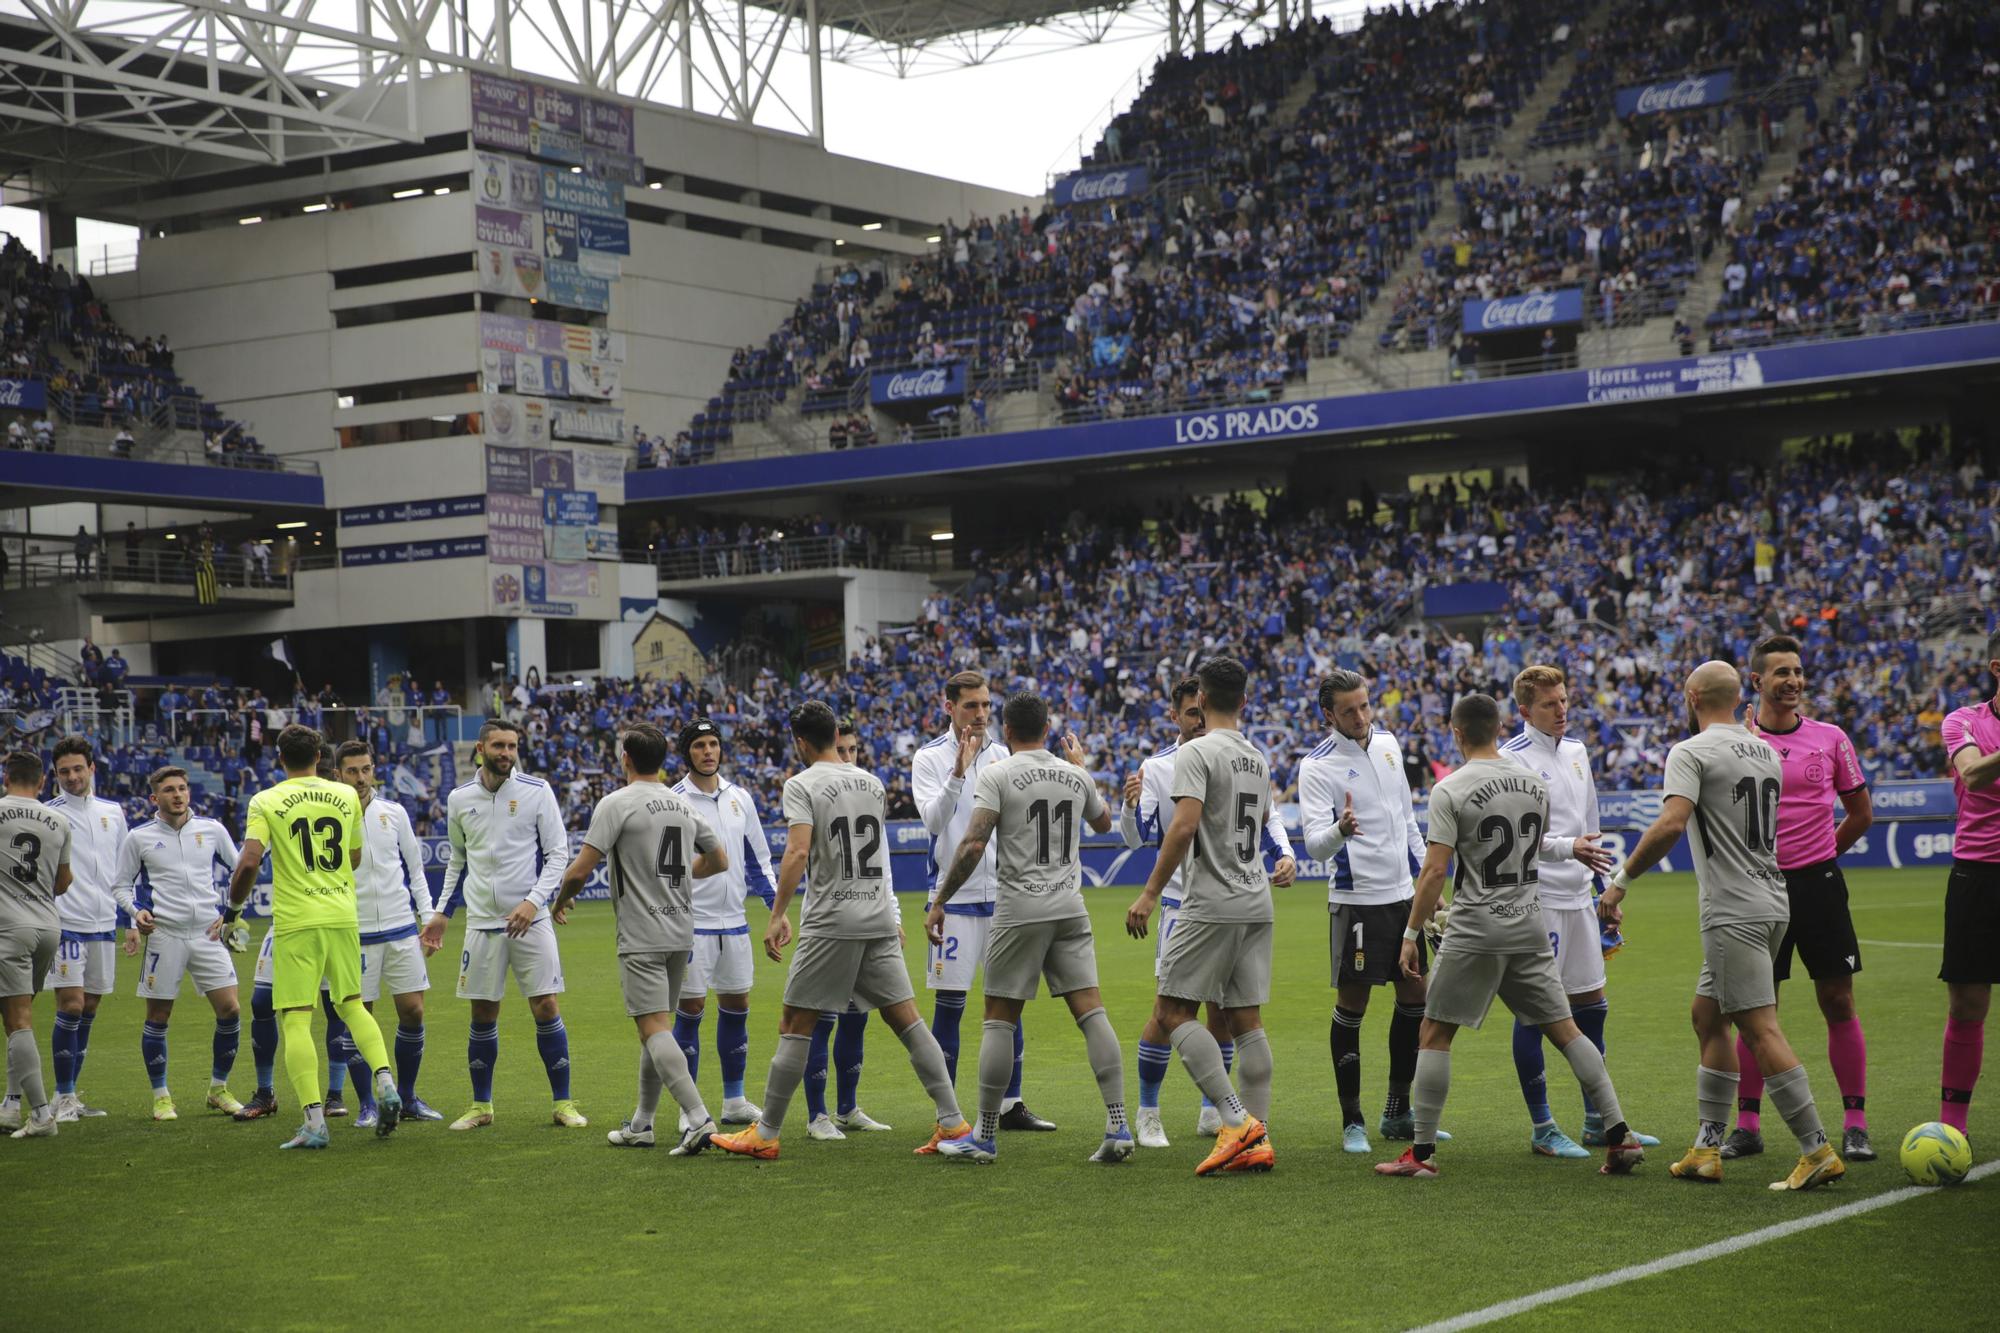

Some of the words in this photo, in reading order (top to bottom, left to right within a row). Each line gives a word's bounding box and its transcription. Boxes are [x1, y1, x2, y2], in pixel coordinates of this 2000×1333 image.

[560, 188, 609, 209] NOREÑA
[1175, 414, 1219, 443] LOS
[1225, 403, 1320, 438] PRADOS
[1731, 743, 1772, 761] EKAIN
[821, 779, 852, 805] JUAN
[855, 779, 885, 804] IBIZA
[1013, 768, 1081, 794] GUERRERO
[1471, 779, 1501, 810] MIKI
[1502, 778, 1545, 806] VILLAR
[0, 808, 59, 832] MORILLAS
[646, 800, 690, 818] GOLDAR
[1732, 776, 1780, 852] 10
[1026, 799, 1073, 866] 11
[1235, 792, 1258, 863] 5
[10, 832, 41, 884] 3
[289, 816, 343, 874] 13
[656, 826, 686, 888] 4
[827, 814, 883, 880] 12
[1478, 812, 1542, 889] 22
[830, 888, 877, 901] sesderma
[1023, 880, 1074, 893] sesderma
[936, 936, 959, 960] 12
[1352, 922, 1364, 950] 1
[60, 940, 80, 960] 10
[151, 953, 160, 973] 7
[462, 950, 470, 972] 9
